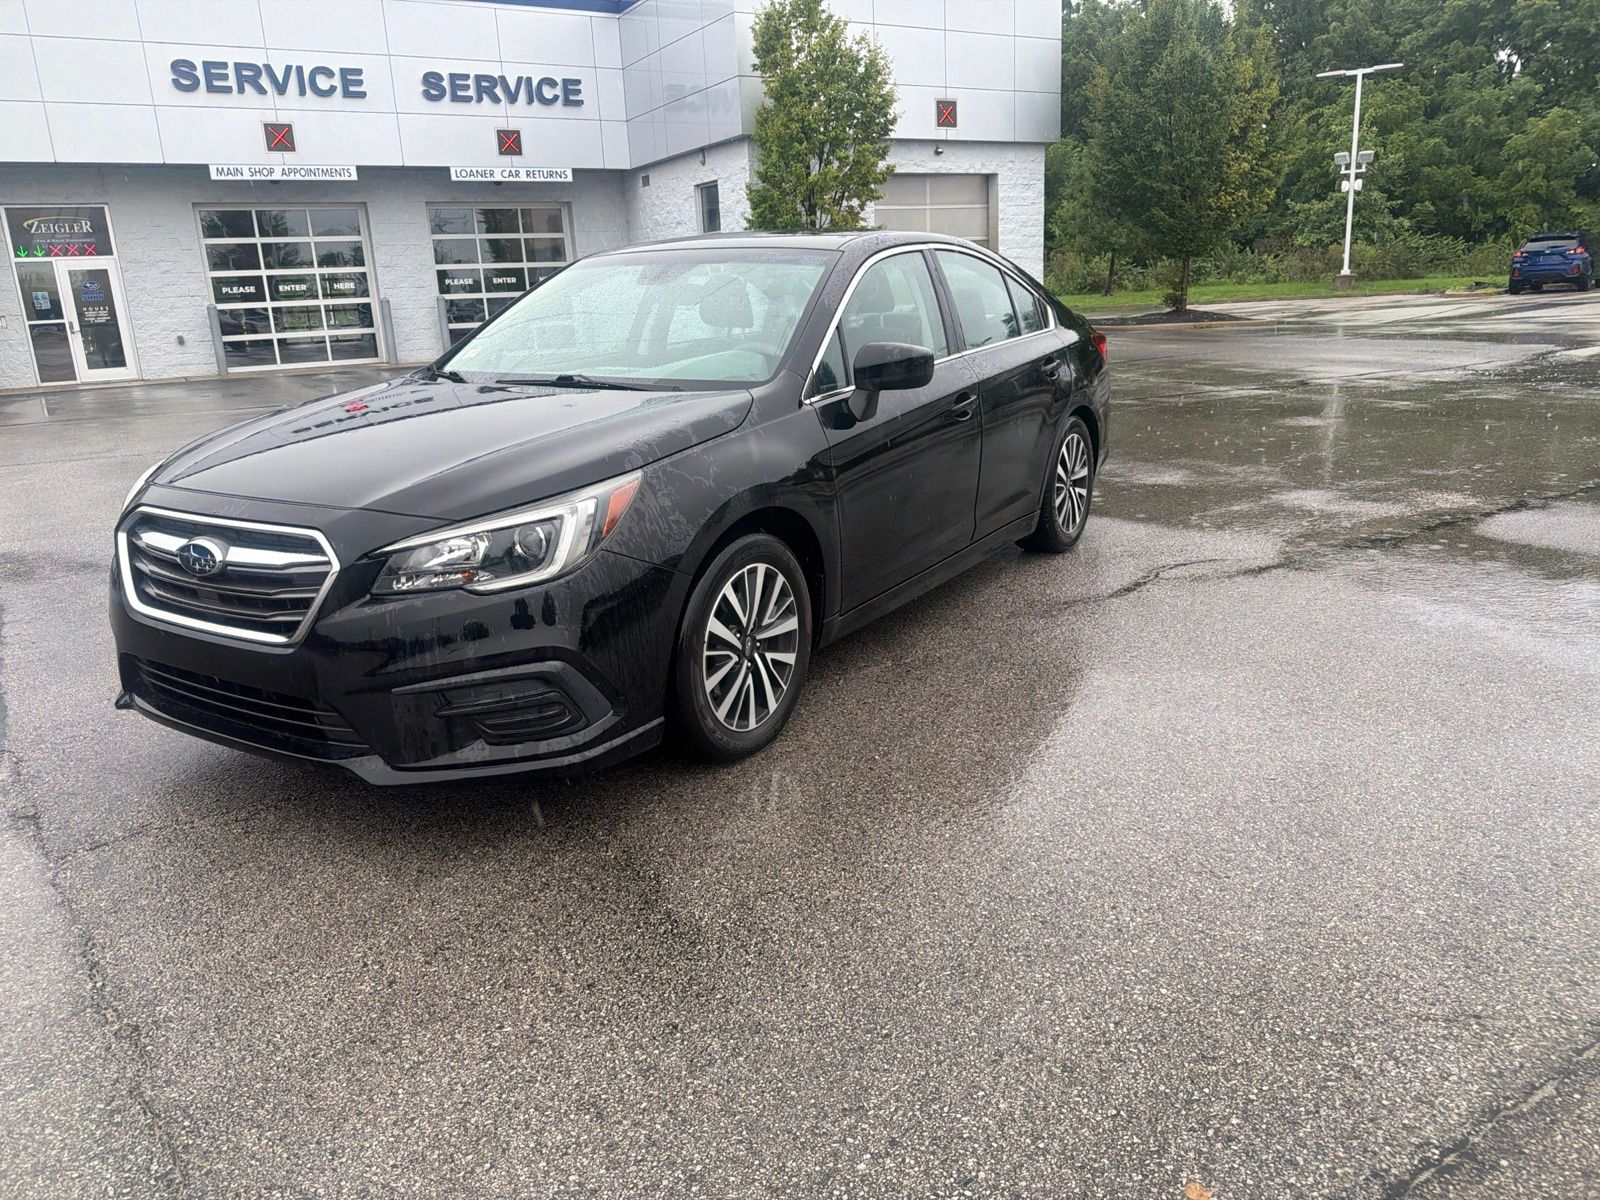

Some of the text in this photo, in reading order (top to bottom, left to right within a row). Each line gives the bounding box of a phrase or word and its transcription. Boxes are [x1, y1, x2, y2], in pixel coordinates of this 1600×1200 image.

[170, 58, 367, 99] SERVICE
[421, 70, 585, 107] SERVICE
[216, 166, 352, 179] MAIN SHOP APPOINTMENTS
[455, 169, 568, 180] LOANER CAR RETURNS
[30, 220, 93, 234] ZEIGLER
[222, 282, 355, 294] PLEASE ENTER HERE
[445, 278, 473, 286] PLEASE
